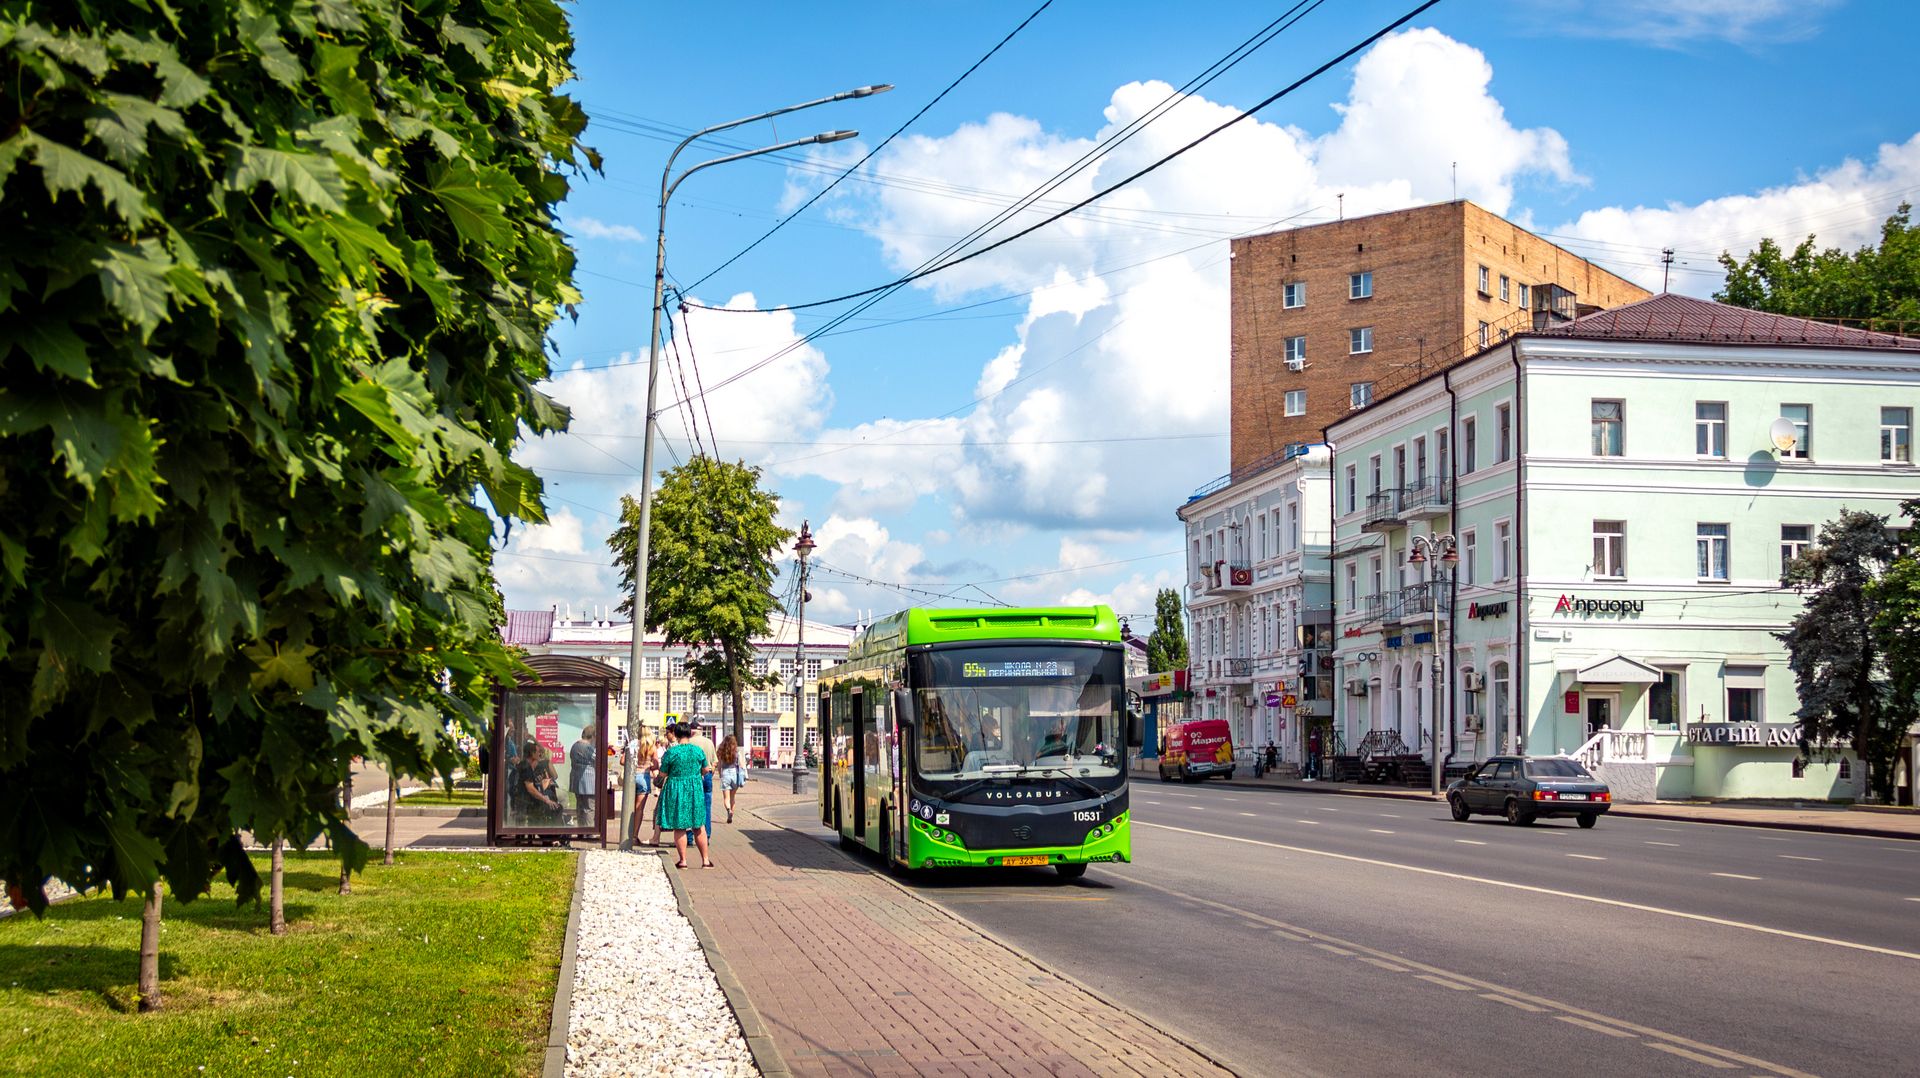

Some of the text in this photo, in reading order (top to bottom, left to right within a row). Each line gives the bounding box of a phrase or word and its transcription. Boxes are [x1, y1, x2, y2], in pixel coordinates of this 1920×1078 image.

[1688, 724, 1761, 743] СТАРЫЙ
[986, 790, 1062, 799] VOLGABUS
[1073, 811, 1100, 822] 10531
[1019, 857, 1033, 865] 323
